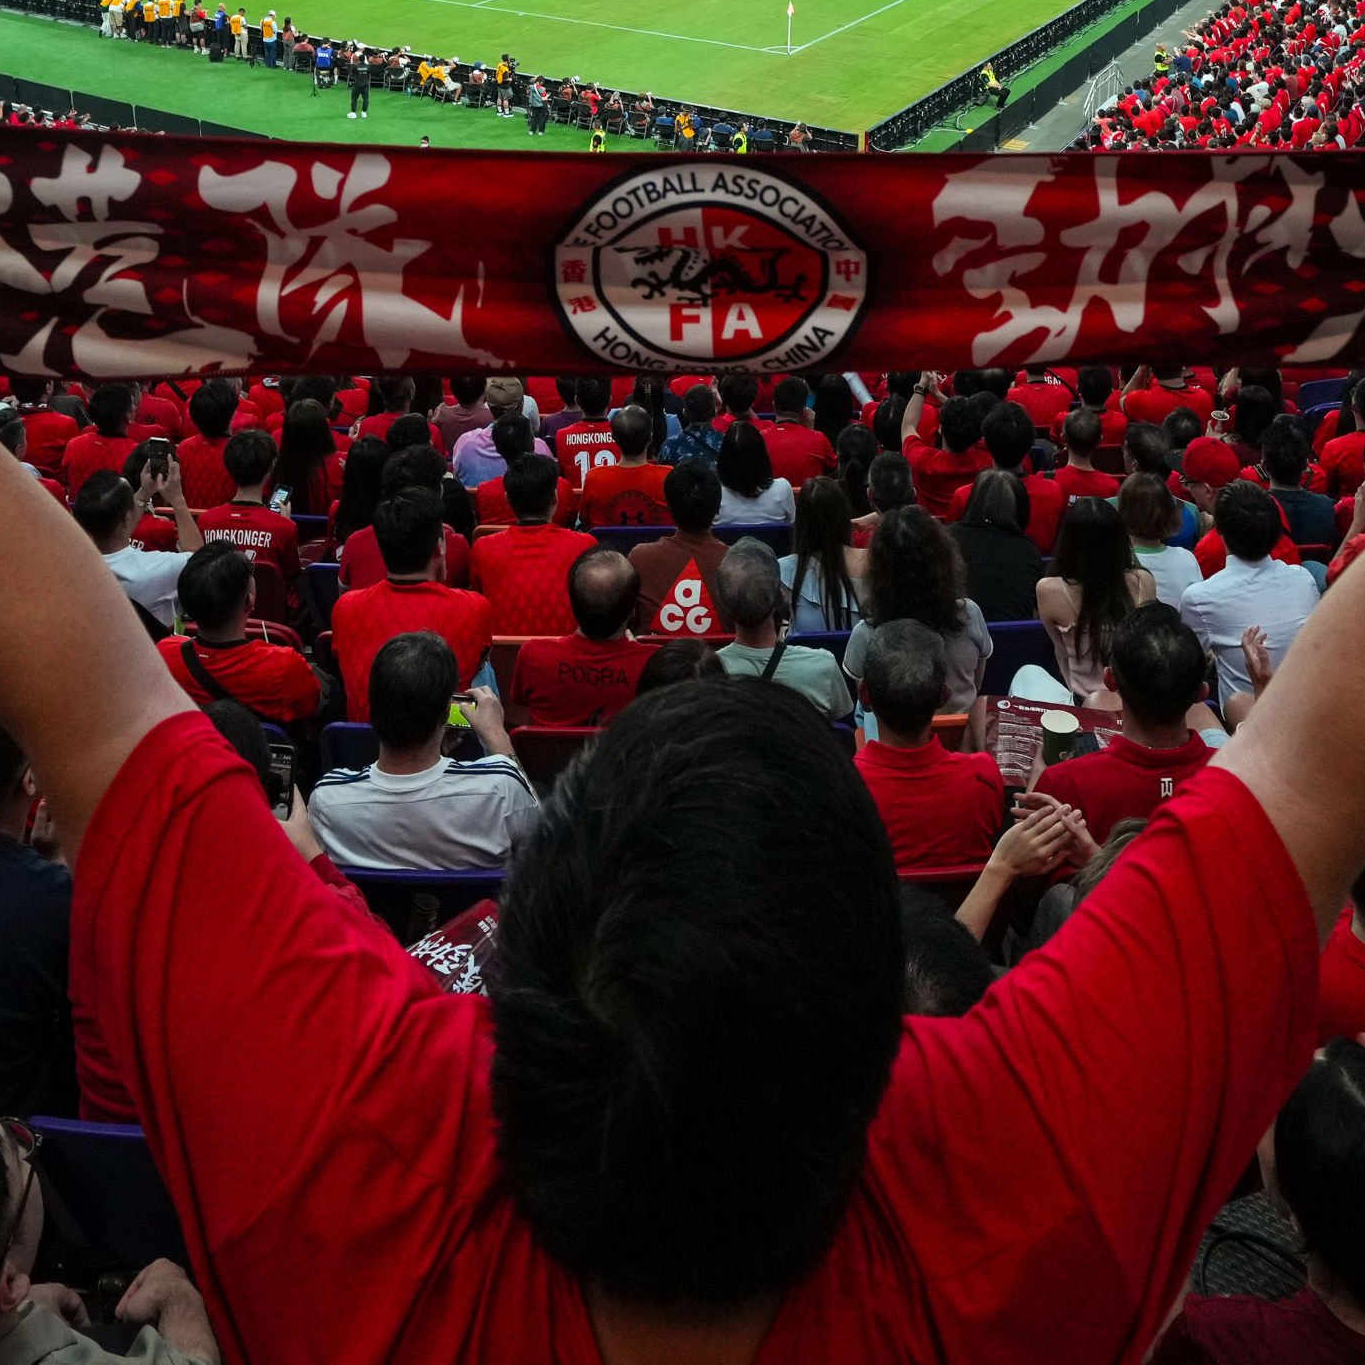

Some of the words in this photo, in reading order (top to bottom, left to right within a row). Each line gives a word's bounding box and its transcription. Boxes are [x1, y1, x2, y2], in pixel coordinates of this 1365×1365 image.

[583, 172, 706, 237] FOOTBALL
[669, 302, 764, 342] FA
[592, 327, 668, 372] HONG
[771, 326, 835, 373] CHINA
[204, 528, 272, 547] HONGKONGER
